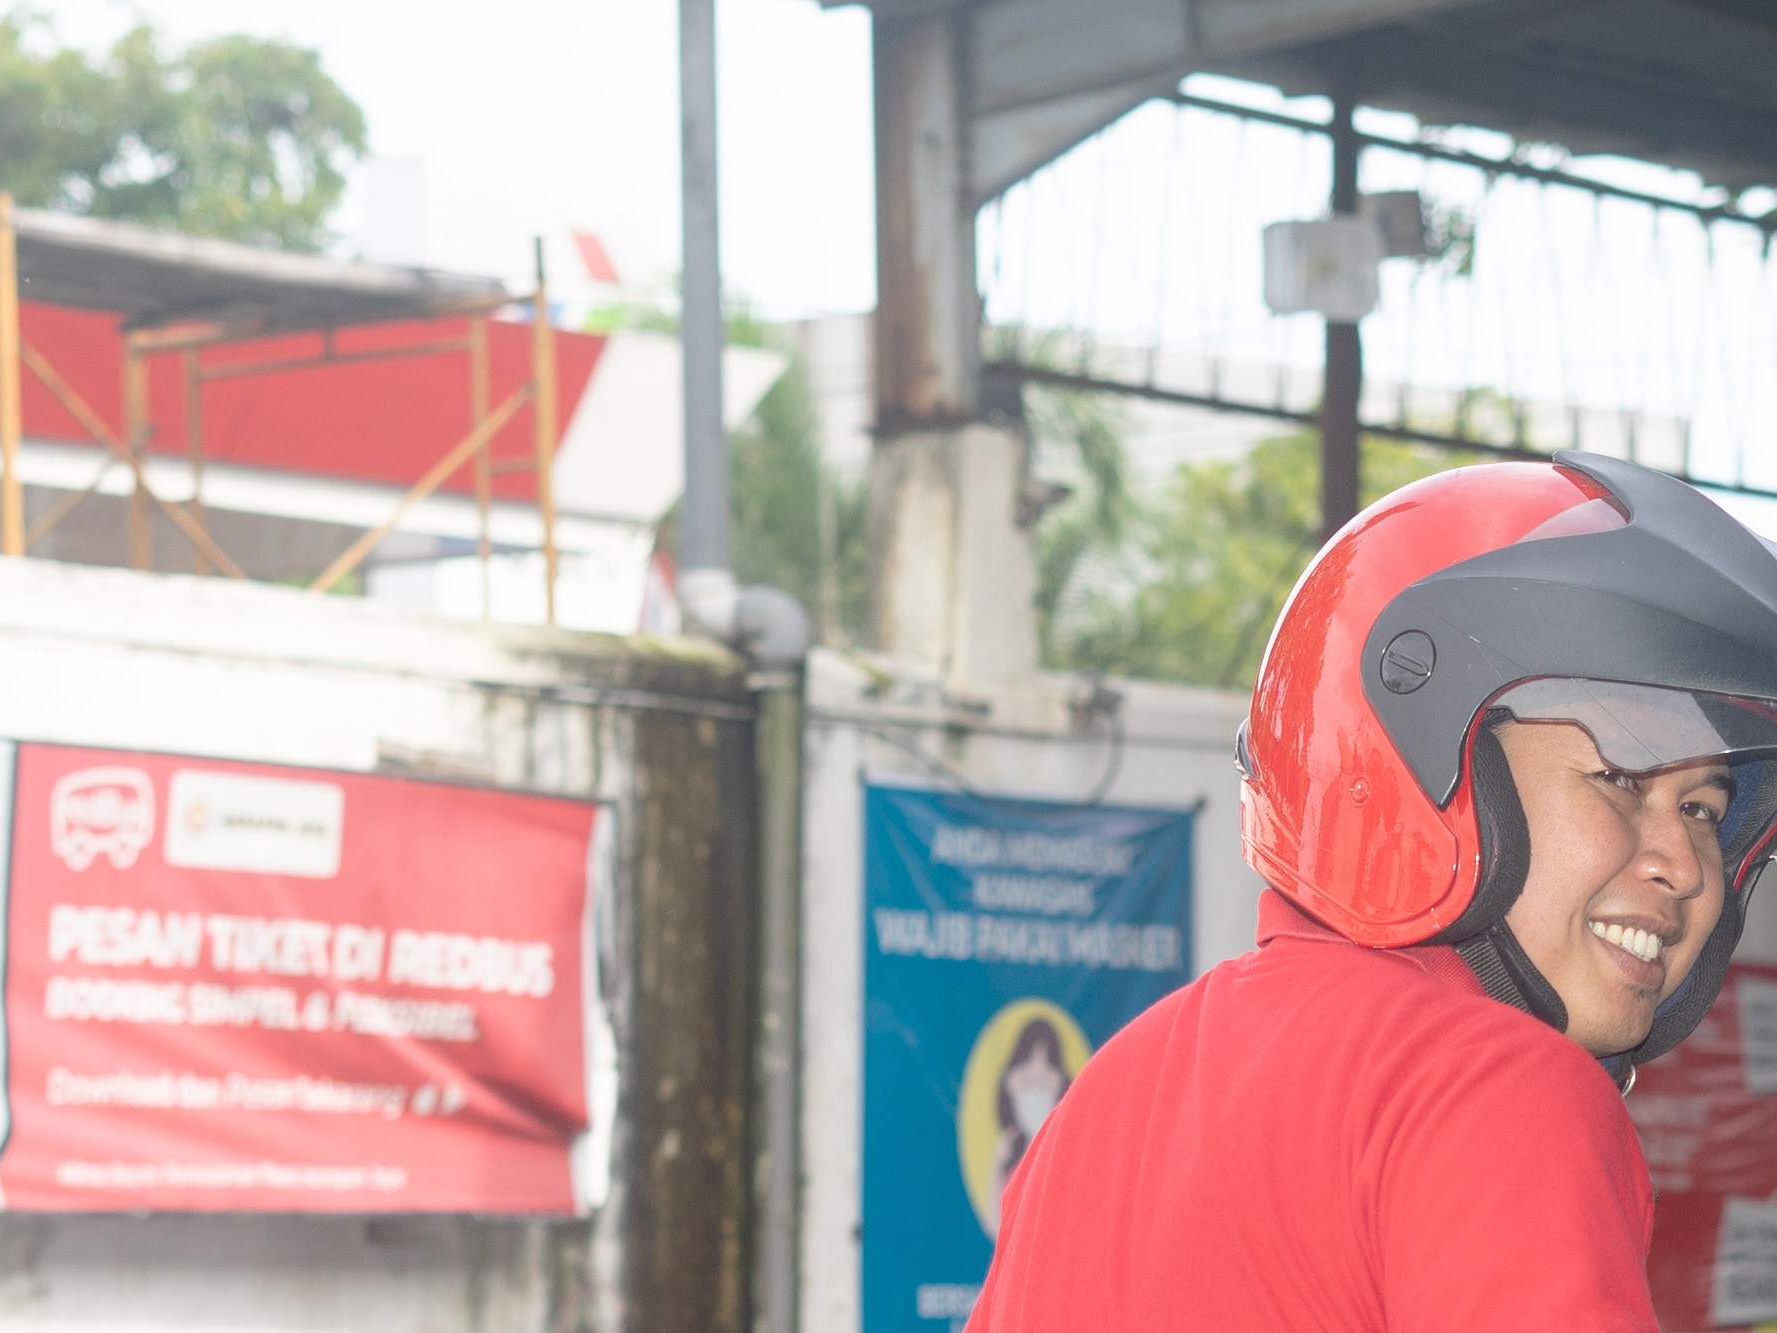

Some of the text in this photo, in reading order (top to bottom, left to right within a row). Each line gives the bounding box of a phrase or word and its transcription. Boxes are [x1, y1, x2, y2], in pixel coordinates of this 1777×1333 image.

[48, 903, 555, 999] PESAN TIKET DI REDBUS
